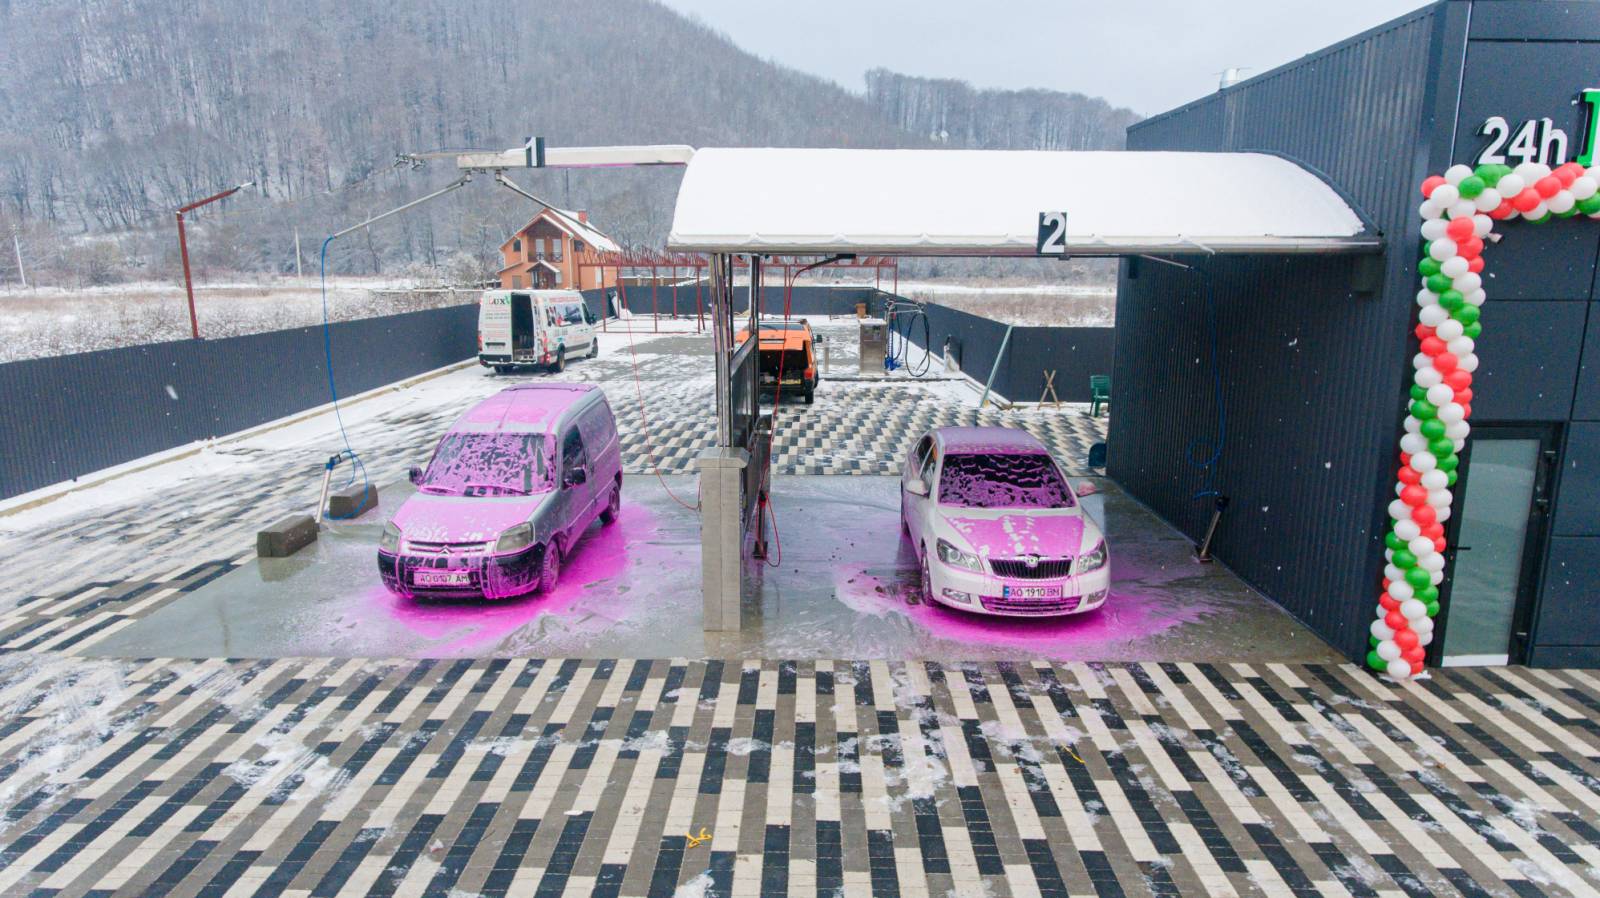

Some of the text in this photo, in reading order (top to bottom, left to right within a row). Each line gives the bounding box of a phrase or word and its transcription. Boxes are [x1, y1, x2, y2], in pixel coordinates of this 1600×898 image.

[525, 136, 538, 167] 1
[1478, 116, 1568, 165] 24h
[1040, 211, 1066, 254] 2
[456, 574, 468, 583] AM
[1011, 588, 1023, 597] AO
[1025, 588, 1046, 597] 1910
